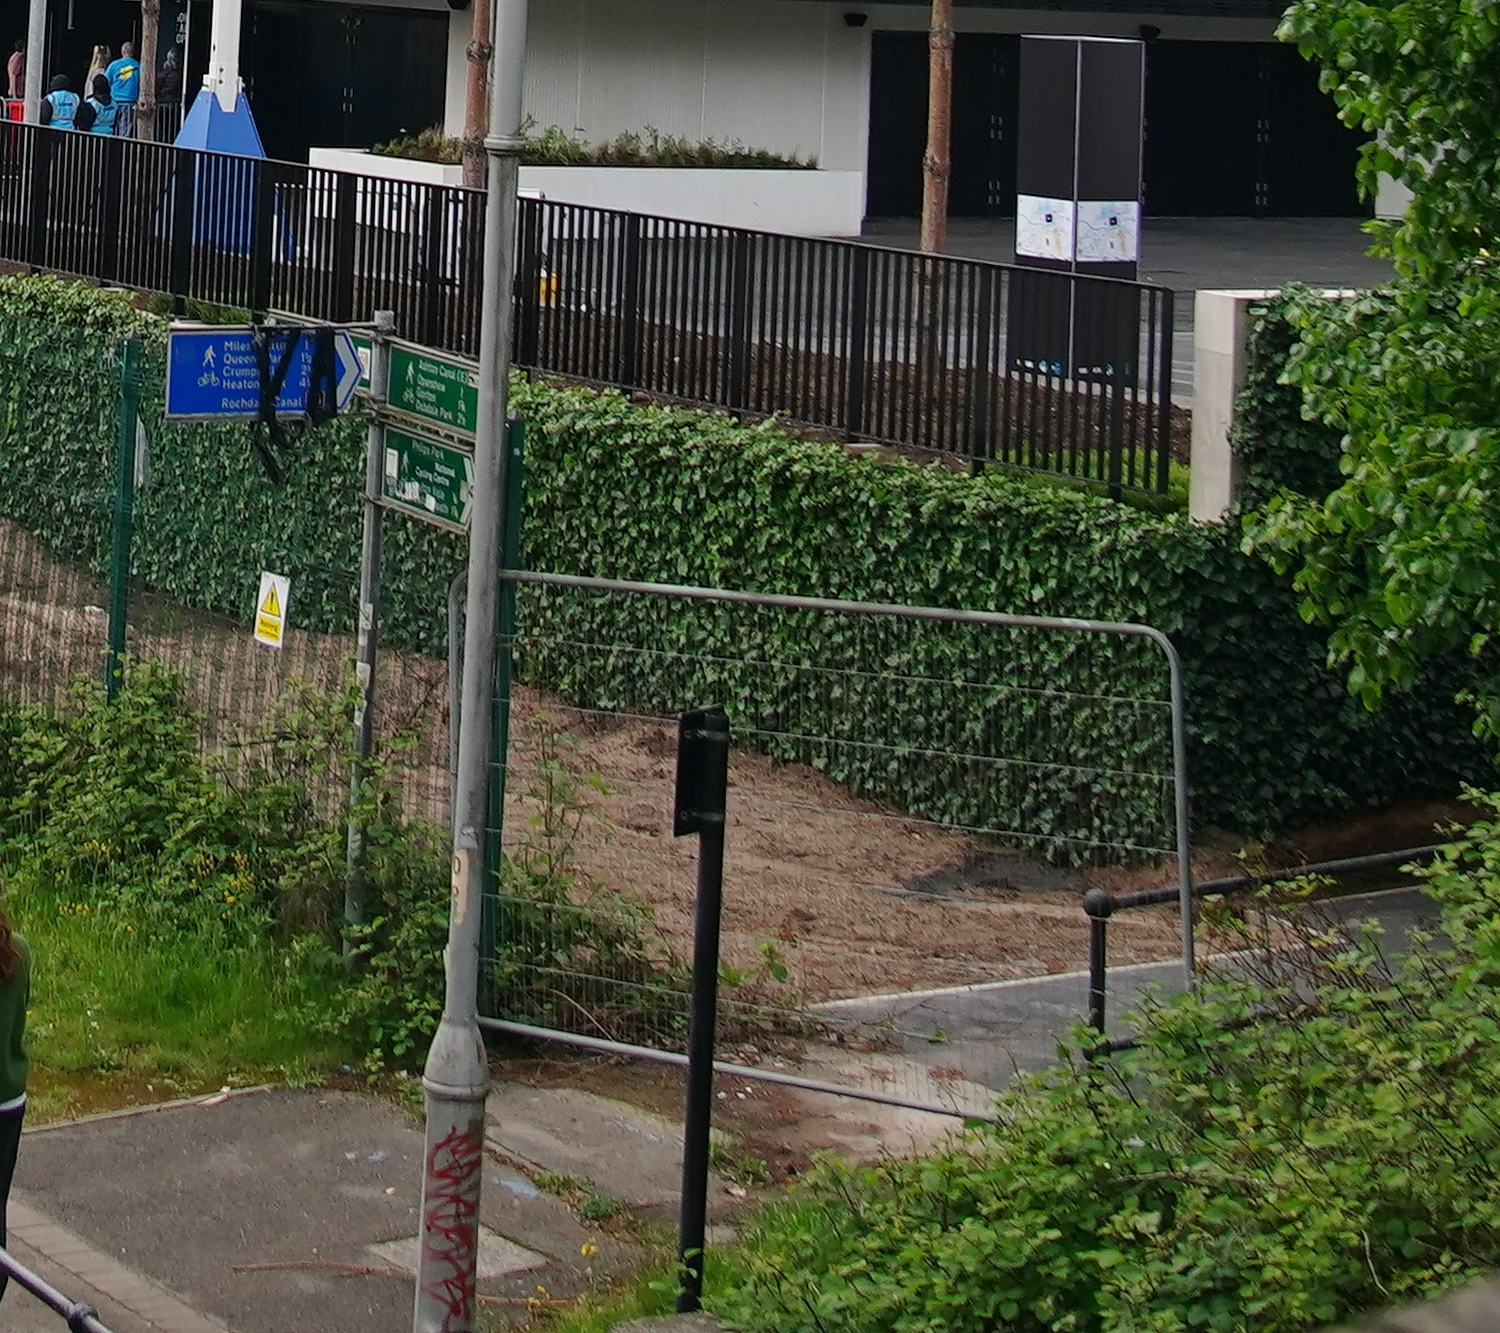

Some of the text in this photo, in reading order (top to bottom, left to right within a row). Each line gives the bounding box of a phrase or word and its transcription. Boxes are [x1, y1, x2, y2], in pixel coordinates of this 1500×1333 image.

[223, 353, 256, 365] Queen
[222, 379, 260, 390] Heaton
[221, 397, 260, 409] Rochda
